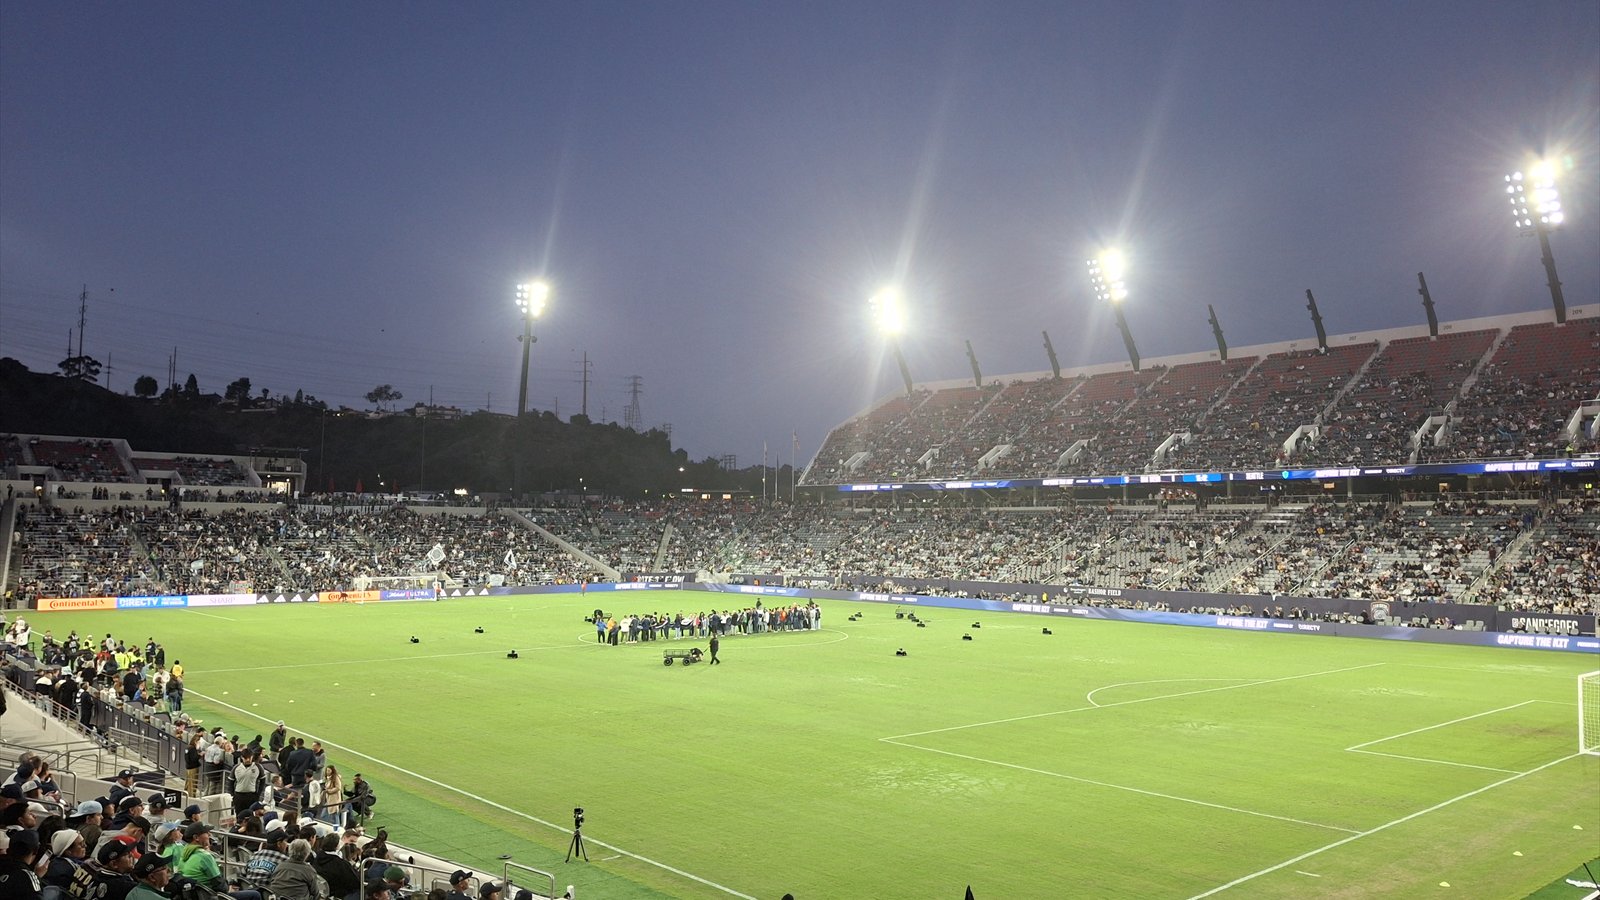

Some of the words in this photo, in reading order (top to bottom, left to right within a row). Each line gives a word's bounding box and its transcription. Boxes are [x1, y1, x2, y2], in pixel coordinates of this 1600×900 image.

[49, 600, 98, 609] Continental
[119, 598, 159, 607] DIRECTV
[1519, 617, 1578, 633] SANDEGOFC
[1497, 634, 1534, 647] CAPTURE
[1536, 637, 1551, 647] THE
[1552, 638, 1569, 649] KIT
